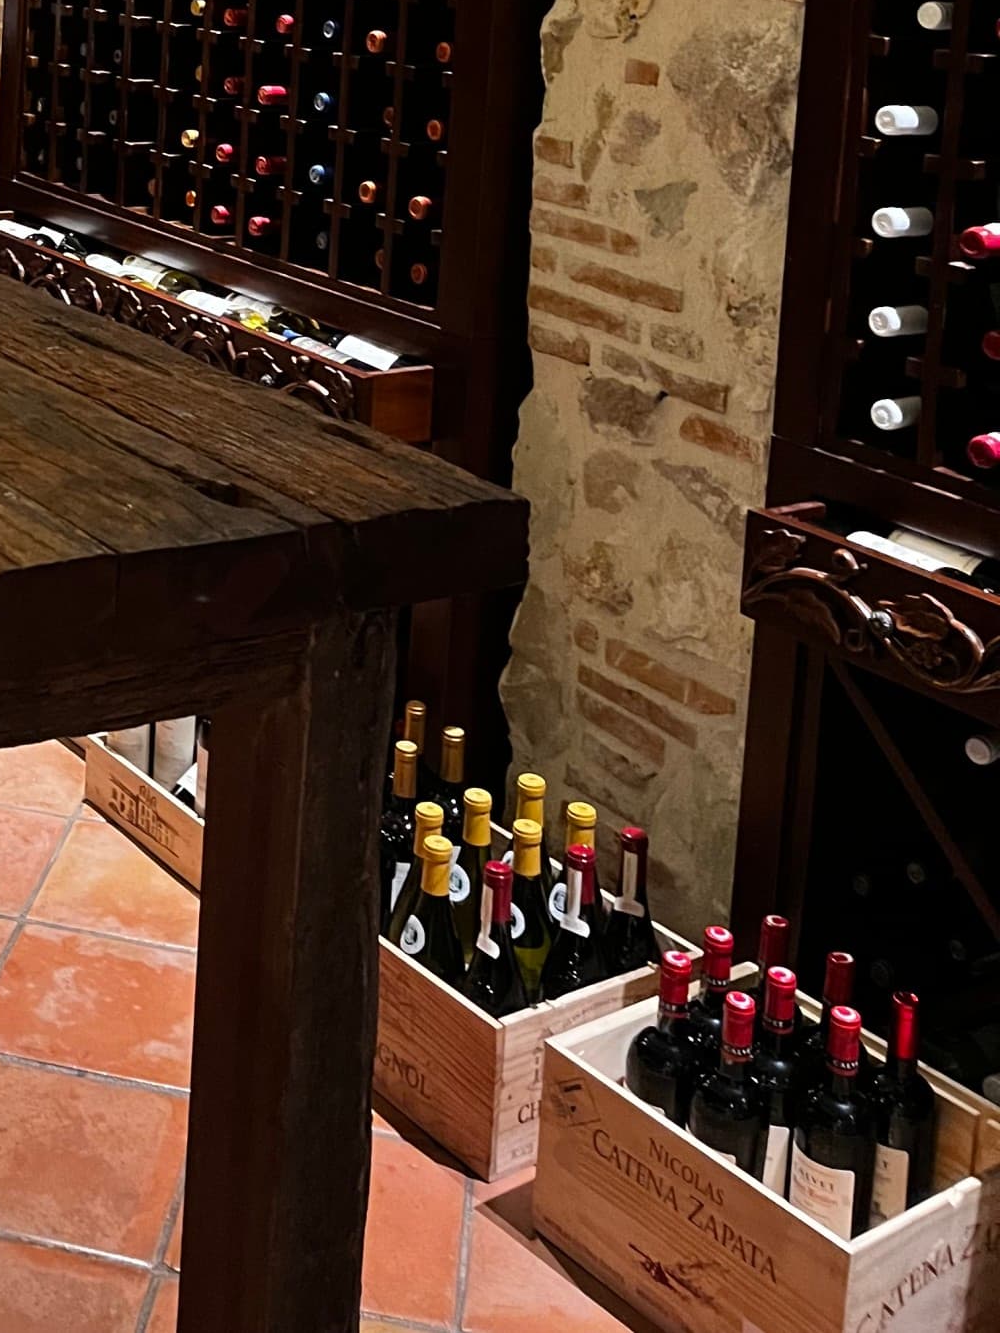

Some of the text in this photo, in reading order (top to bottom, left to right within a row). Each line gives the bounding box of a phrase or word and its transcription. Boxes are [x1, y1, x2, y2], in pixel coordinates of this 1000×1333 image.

[592, 1129, 679, 1212] CATENA
[687, 1194, 778, 1284] ZAPATA
[648, 1137, 725, 1206] NICOLAS
